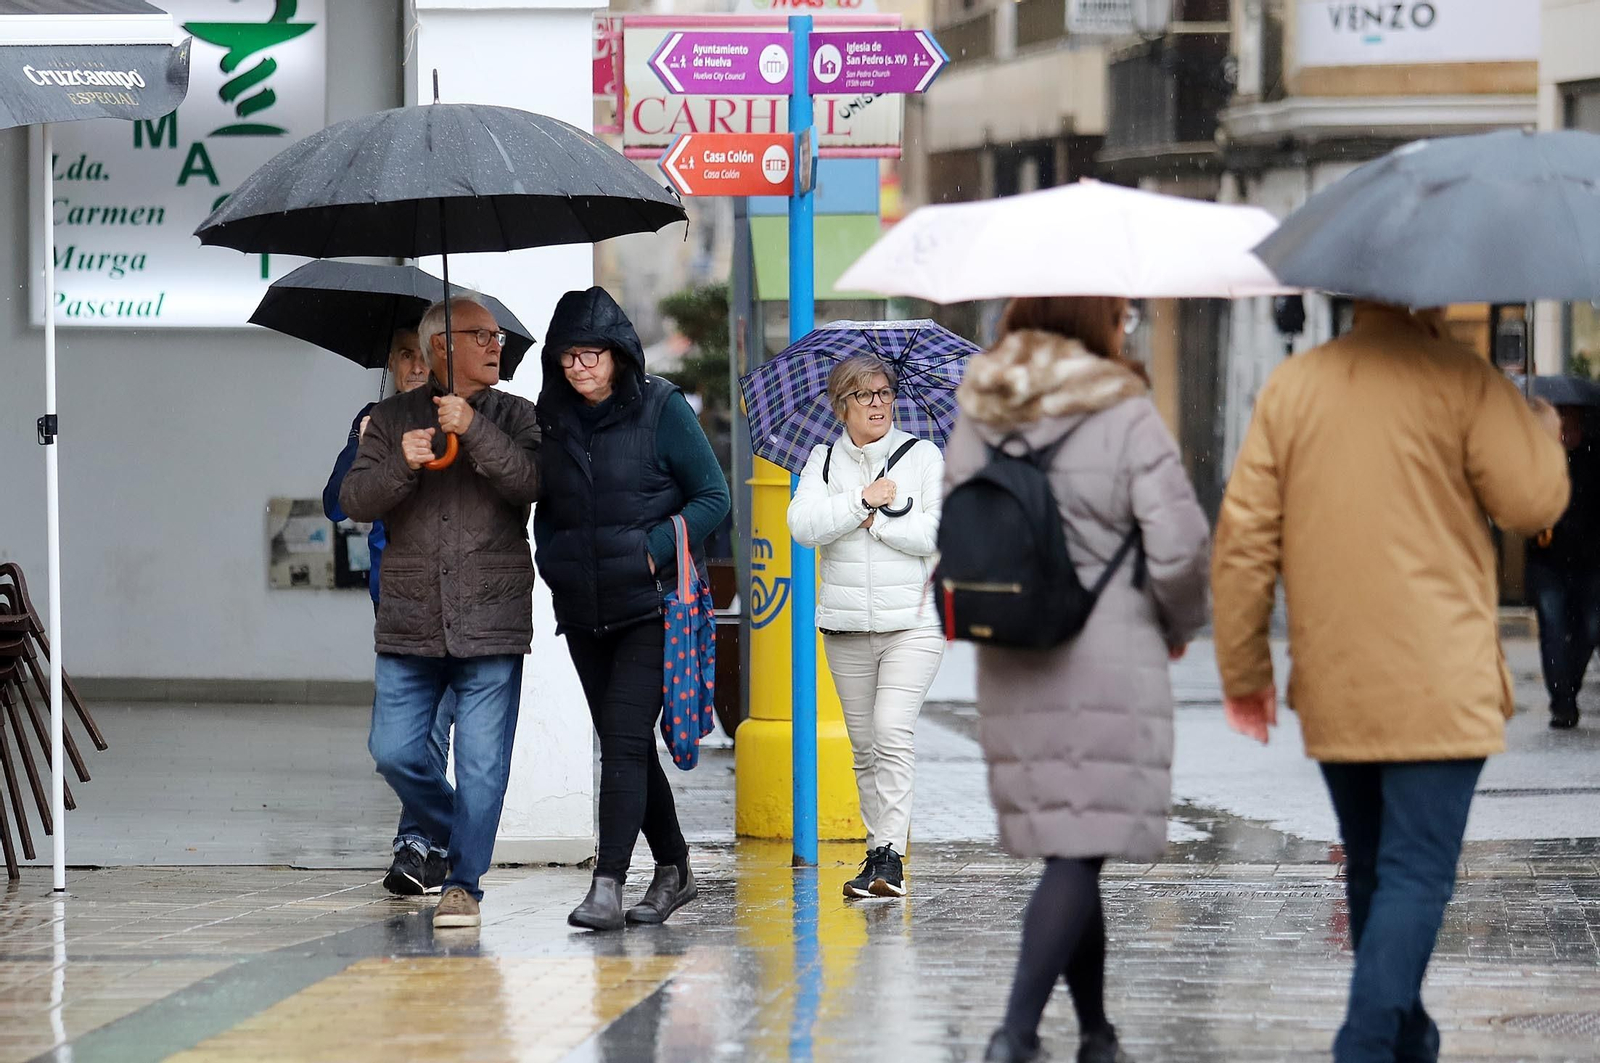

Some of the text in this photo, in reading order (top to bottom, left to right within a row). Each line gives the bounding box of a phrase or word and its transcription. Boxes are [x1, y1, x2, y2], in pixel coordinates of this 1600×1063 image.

[1328, 2, 1436, 32] VENZO
[693, 44, 748, 55] Ayuntamiento
[846, 42, 882, 54] Iglesia de
[693, 56, 732, 68] de Huelva
[846, 55, 860, 65] San
[862, 54, 884, 65] Pedro
[894, 54, 907, 66] XV)
[22, 64, 146, 90] Cruzcampo
[693, 72, 745, 82] Huelva City Council
[857, 70, 871, 78] Pedro
[872, 70, 890, 78] Church
[67, 91, 139, 106] ESPECIAL
[632, 97, 851, 137] CARHL
[703, 150, 726, 163] Casa
[727, 150, 754, 163] Colón
[52, 153, 109, 180] Lda.
[703, 169, 740, 179] Casa Colón
[53, 198, 165, 226] Carmen
[53, 246, 147, 279] Murga
